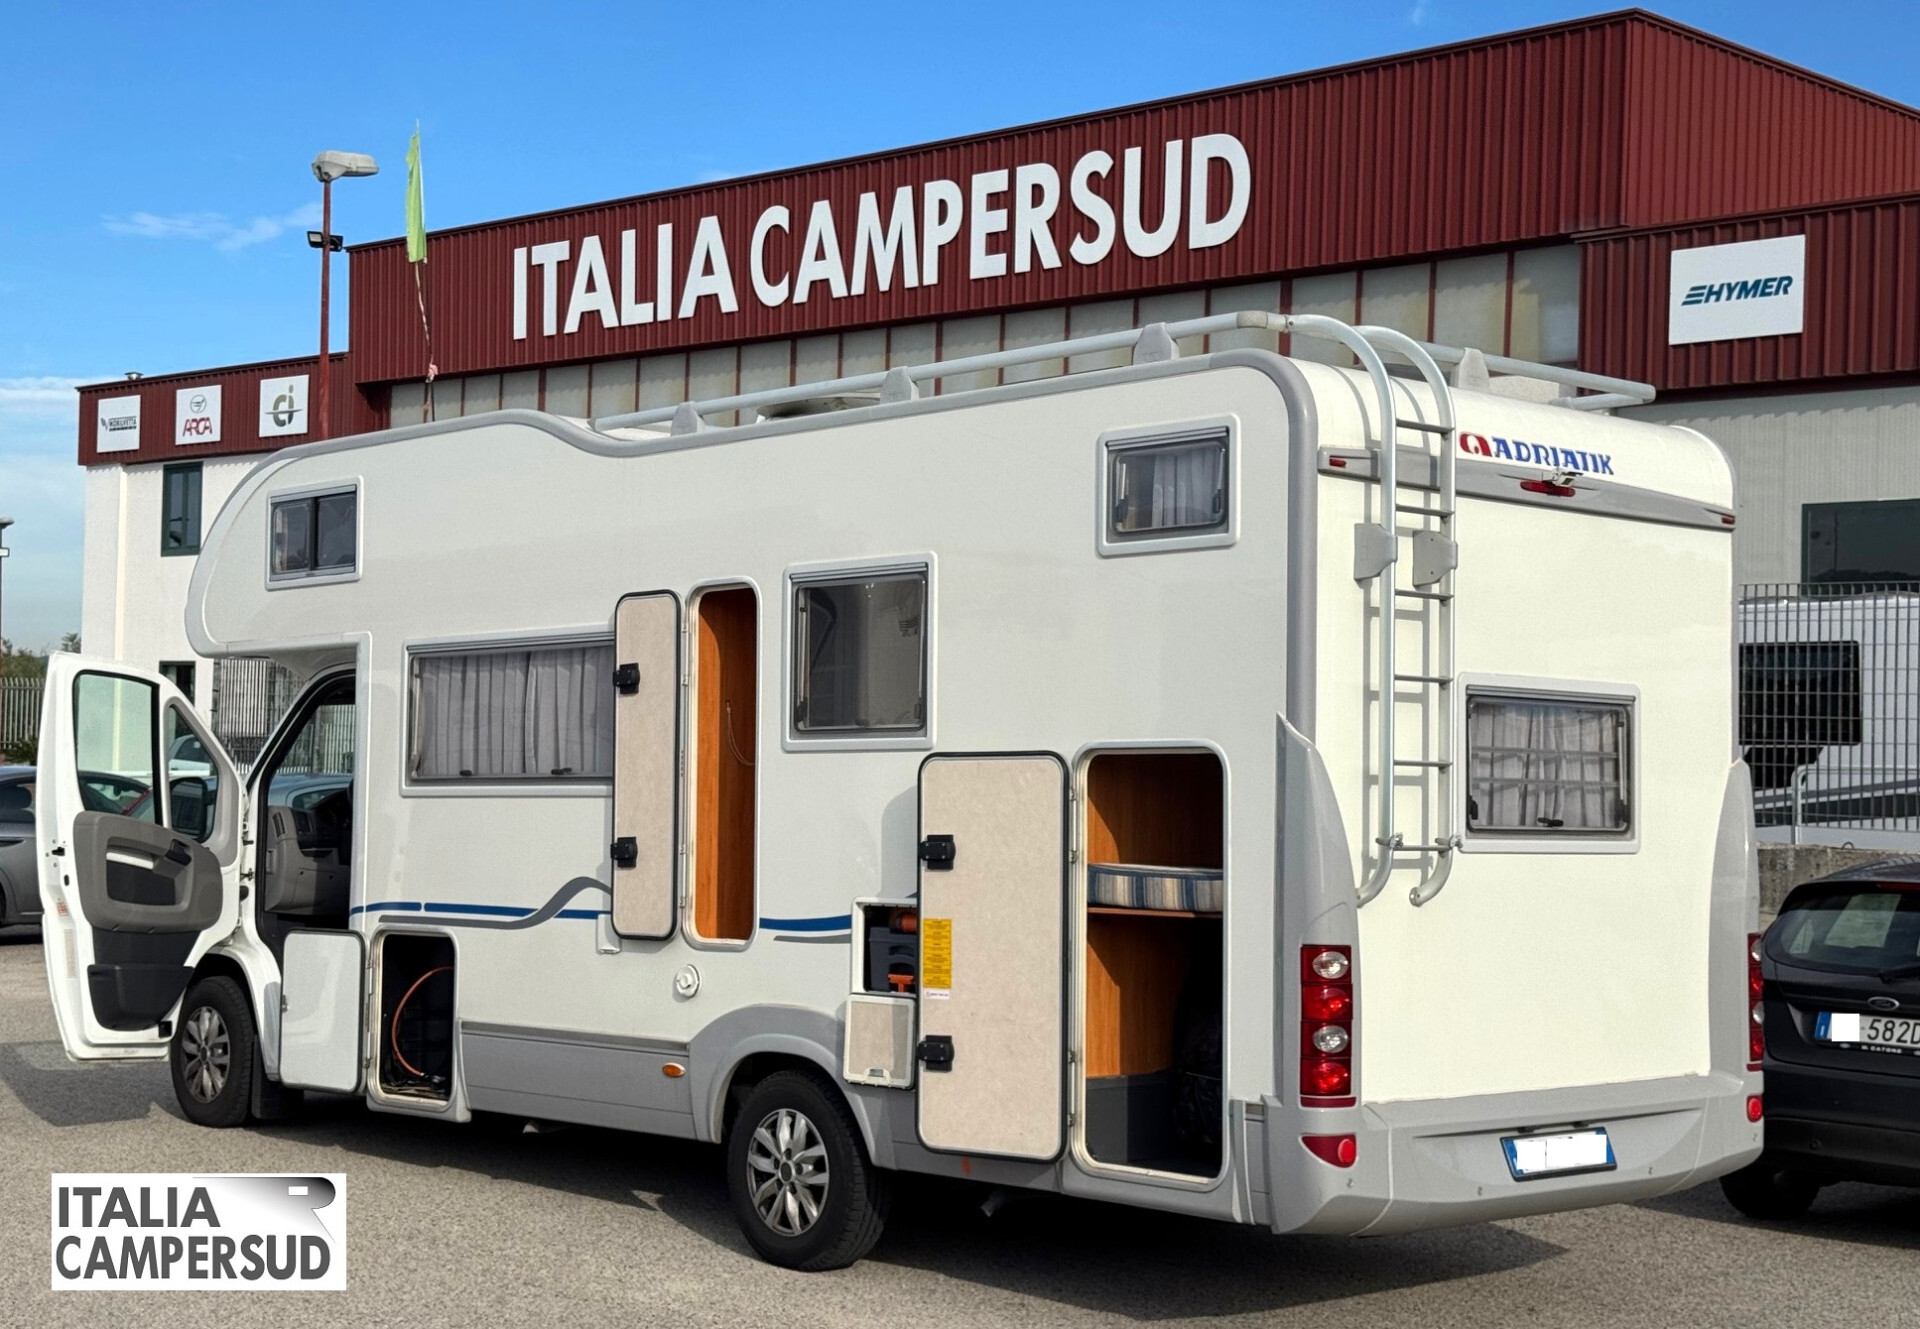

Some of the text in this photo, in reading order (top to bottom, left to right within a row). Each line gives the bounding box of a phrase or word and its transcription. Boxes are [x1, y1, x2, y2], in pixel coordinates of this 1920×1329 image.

[513, 132, 1252, 340] ITALIA CAMPERSUD
[1703, 275, 1793, 304] HYMER
[183, 417, 213, 437] ARCA
[1491, 436, 1615, 476] ADRIATIK
